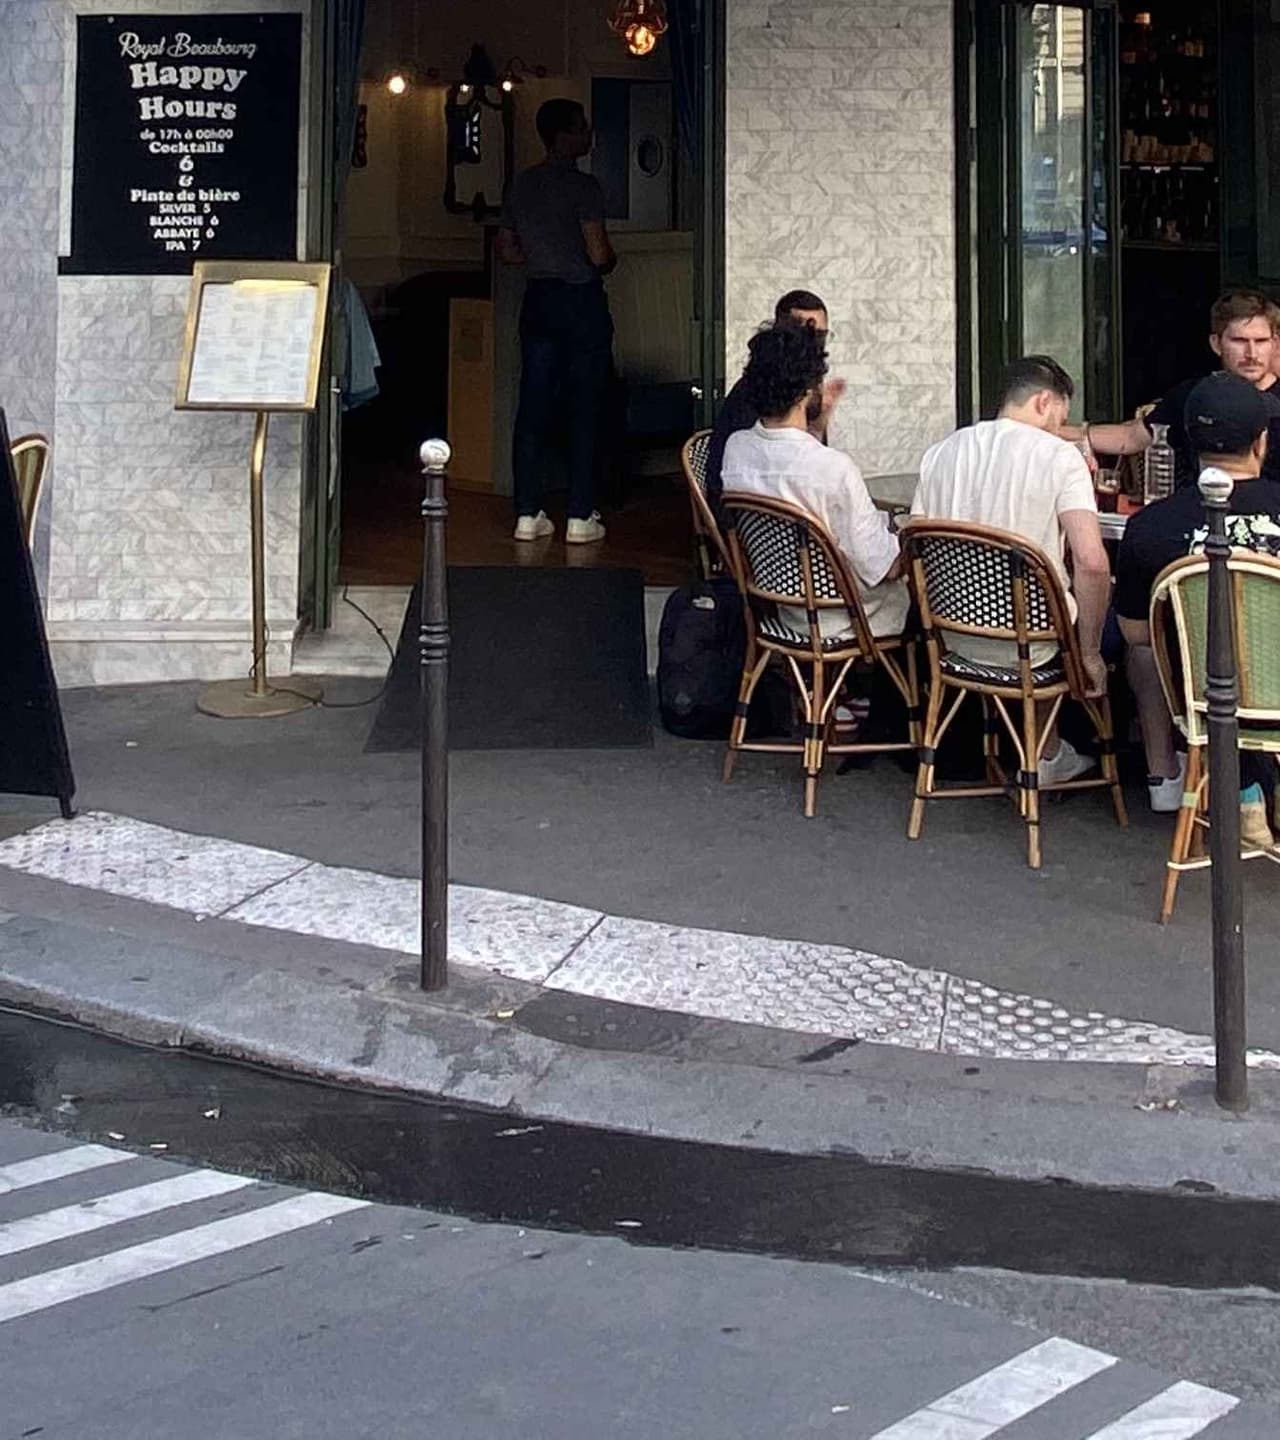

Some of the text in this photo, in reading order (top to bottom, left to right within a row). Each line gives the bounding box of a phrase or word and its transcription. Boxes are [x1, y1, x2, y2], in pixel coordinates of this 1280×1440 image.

[118, 31, 257, 60] Royal Beaubourg
[129, 61, 248, 92] Happy
[138, 96, 237, 120] Hours
[140, 128, 156, 140] de
[160, 129, 181, 140] 17h
[195, 128, 234, 140] 00h00
[148, 141, 225, 153] Cocktails
[179, 155, 194, 172] 6
[178, 174, 194, 187] &
[130, 188, 241, 202] Pinte de bière
[159, 203, 211, 214] SILVER 5
[149, 215, 219, 226] BLANCHE 6
[153, 227, 215, 239] ABBAYE 6
[165, 240, 201, 251] IPA 7
